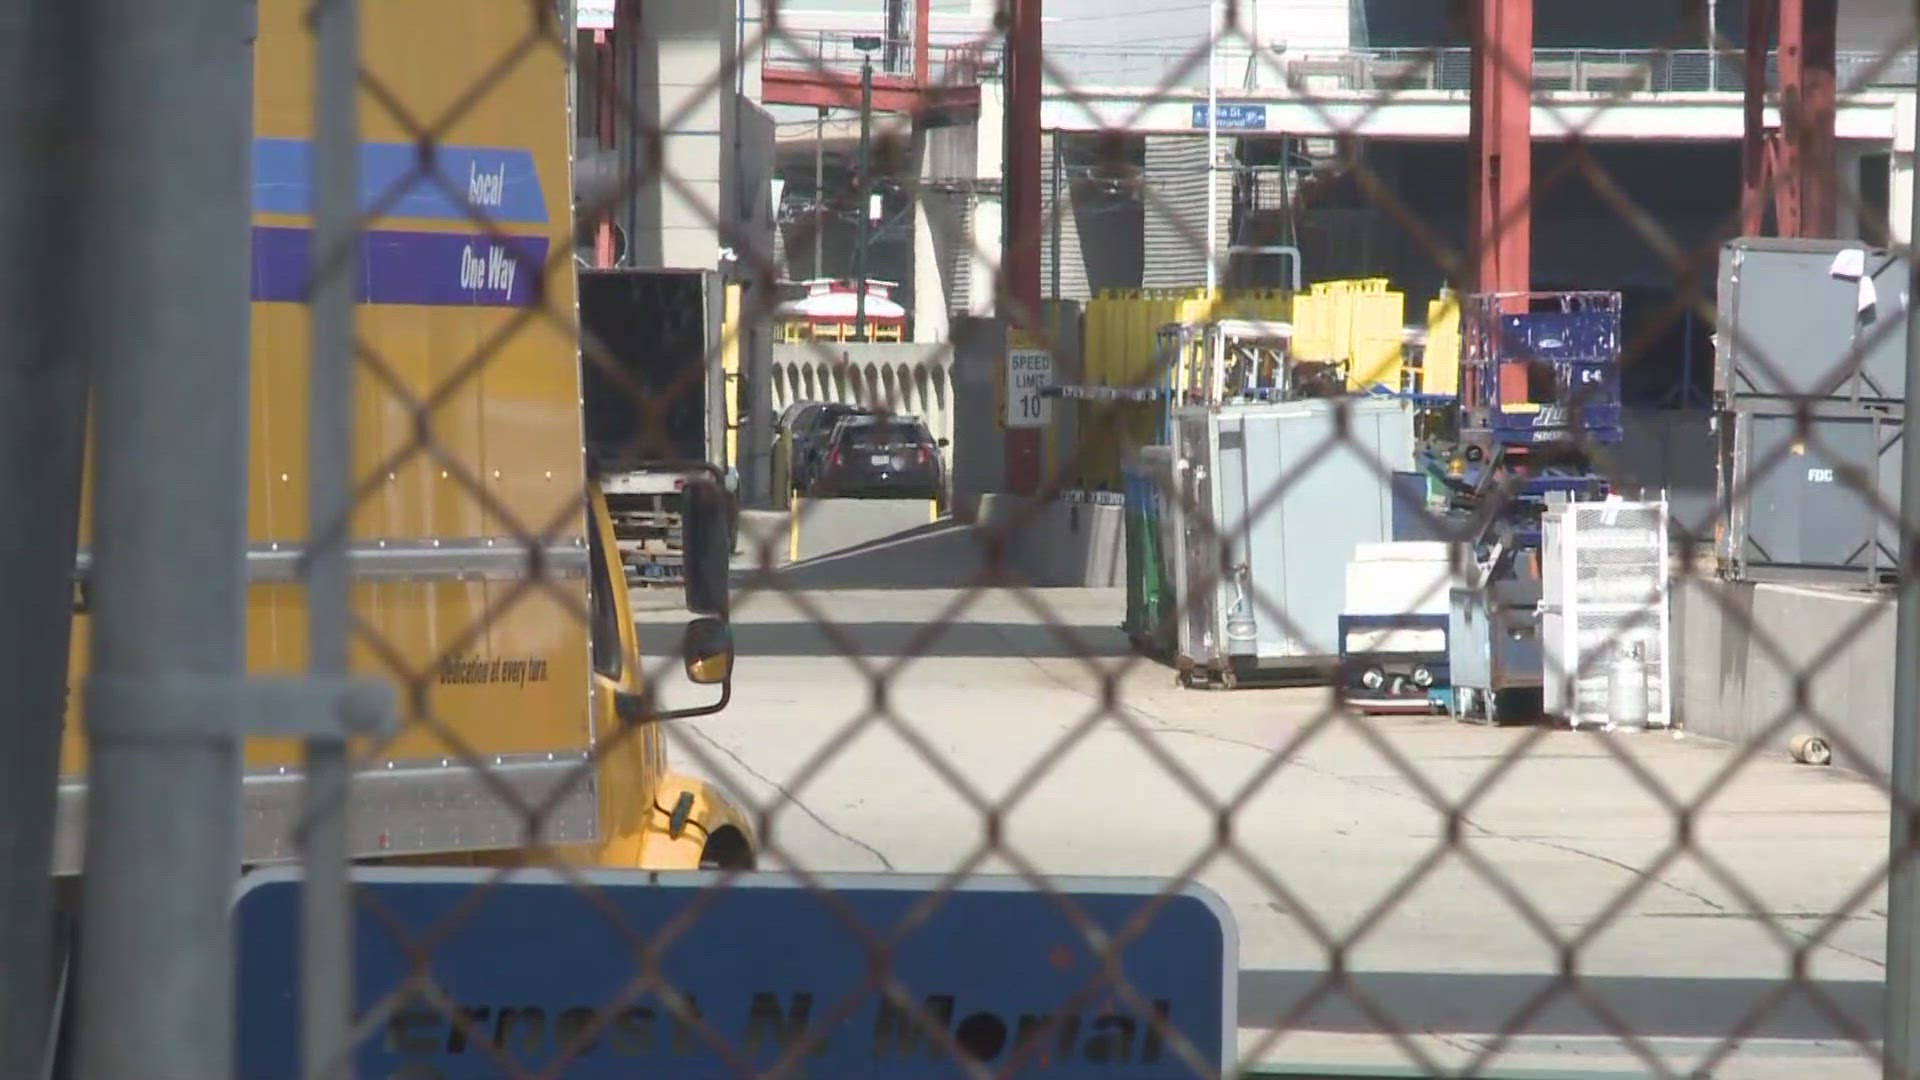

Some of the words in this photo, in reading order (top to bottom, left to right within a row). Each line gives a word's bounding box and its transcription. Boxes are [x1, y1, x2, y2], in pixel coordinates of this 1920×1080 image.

[469, 160, 504, 206] Local
[460, 245, 485, 289] One
[487, 246, 516, 300] Way
[1012, 354, 1050, 371] SPEED
[1015, 373, 1046, 389] LIMIT
[1020, 393, 1042, 419] 10
[1808, 468, 1834, 482] FDC
[386, 990, 702, 1056] Ernest
[872, 994, 1172, 1066] Morial
